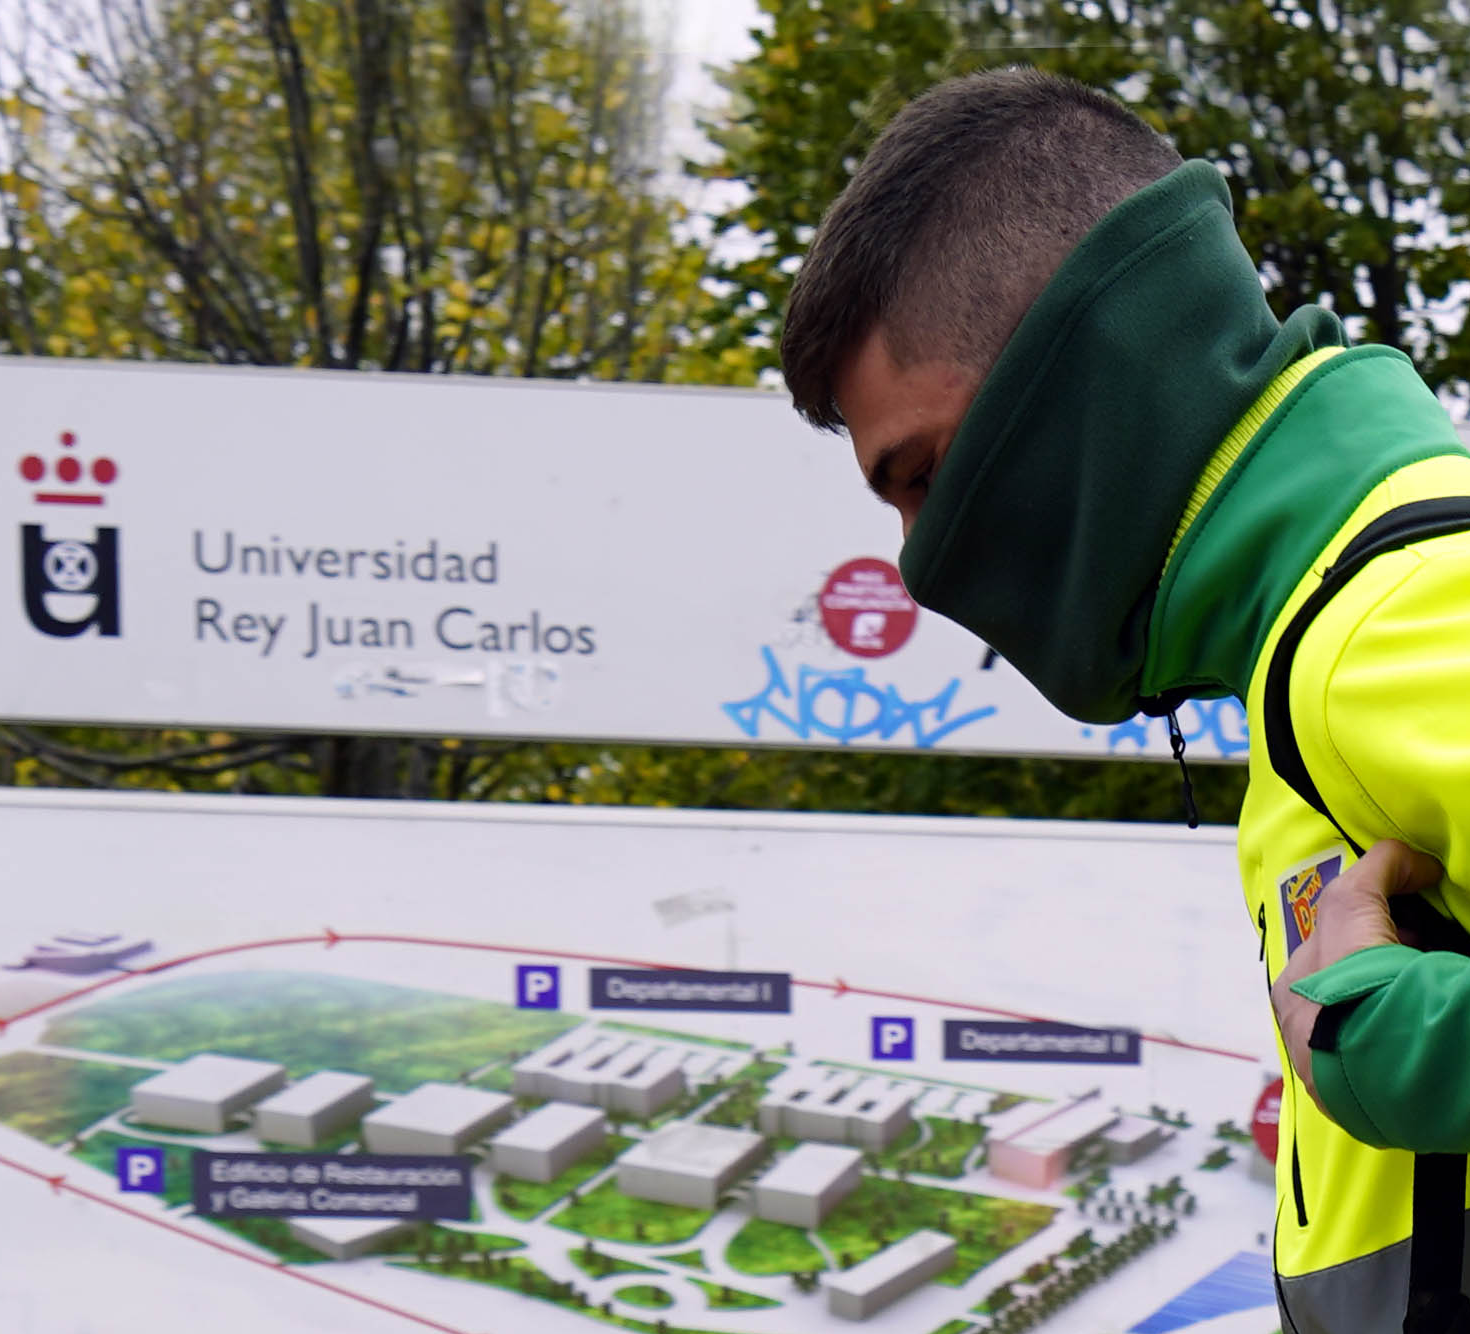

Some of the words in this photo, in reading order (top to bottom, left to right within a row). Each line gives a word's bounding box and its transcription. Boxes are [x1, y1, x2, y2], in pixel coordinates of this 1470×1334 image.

[193, 530, 499, 584] Universidad
[194, 598, 286, 657] Rey
[303, 602, 414, 659] Juan
[435, 606, 597, 656] Carlos
[524, 970, 554, 1004] P
[879, 1022, 909, 1055] P
[128, 1154, 157, 1187] P
